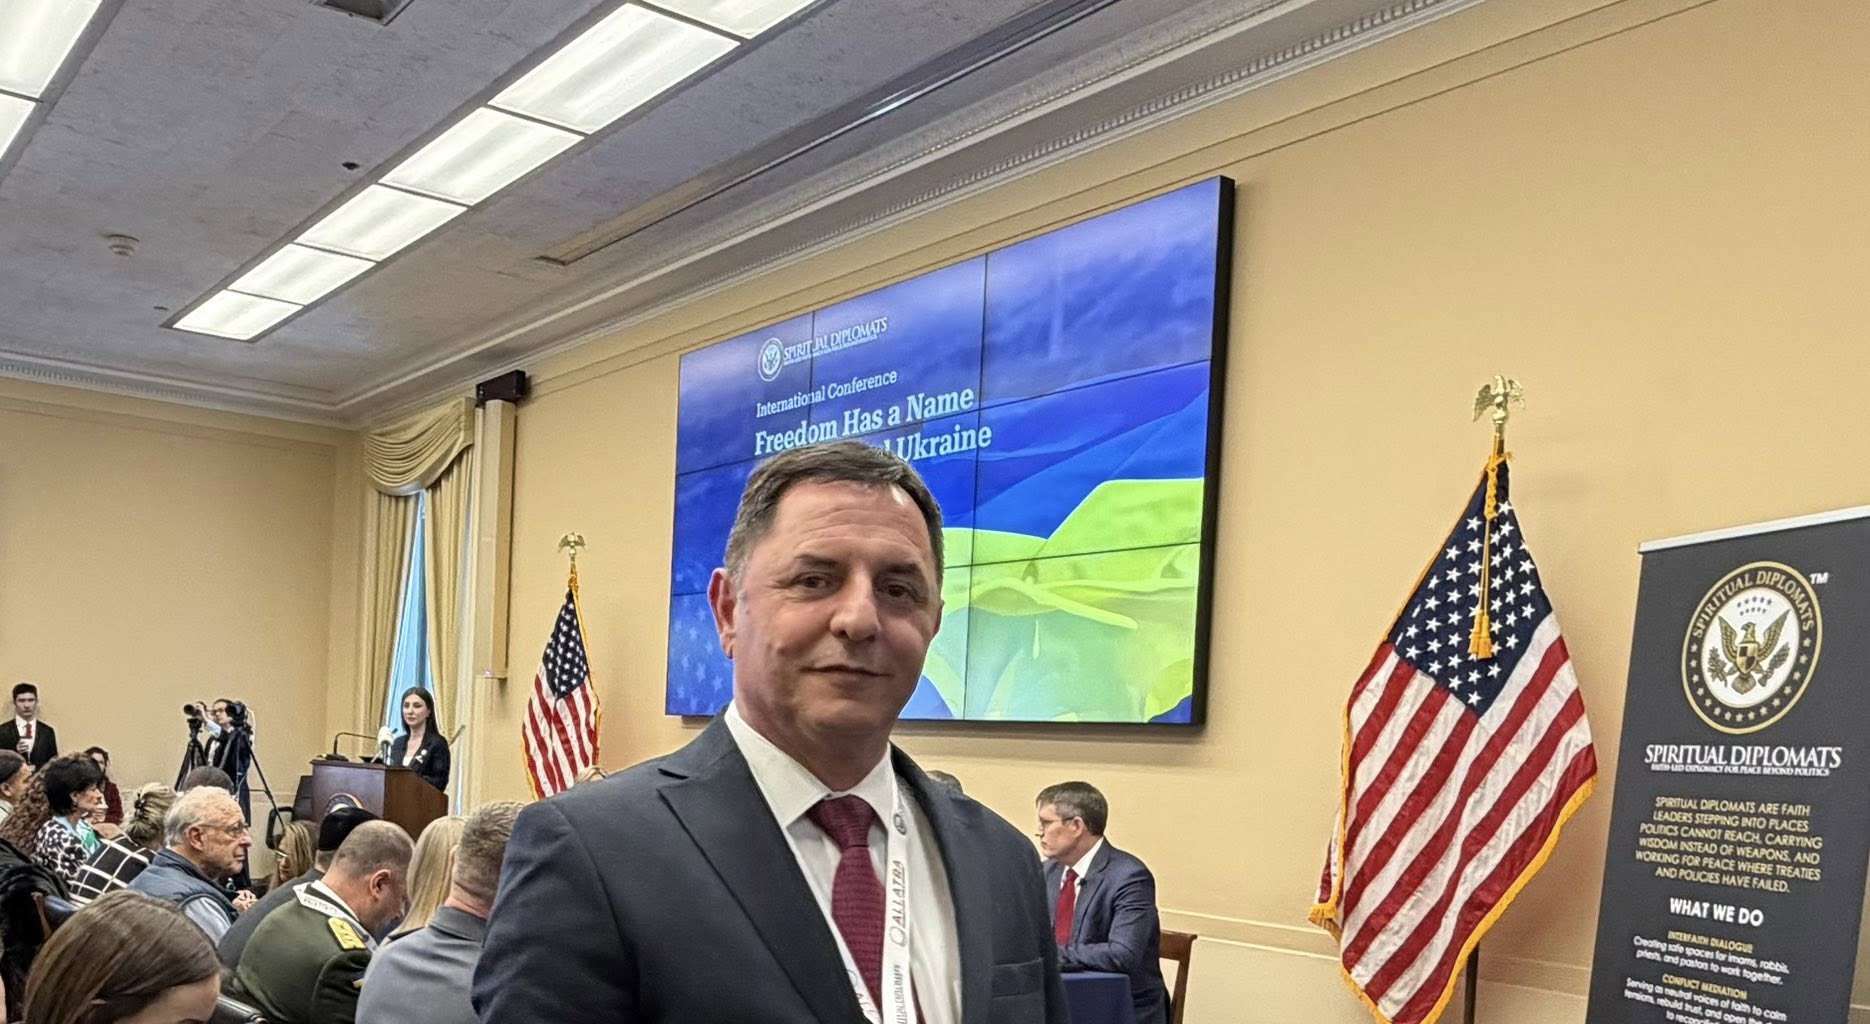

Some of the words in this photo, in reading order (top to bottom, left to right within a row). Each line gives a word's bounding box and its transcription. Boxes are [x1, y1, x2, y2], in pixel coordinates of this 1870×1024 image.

[831, 317, 887, 347] DIPLOMATS
[756, 385, 825, 417] International
[828, 371, 897, 399] Conference
[755, 418, 837, 455] Freedom
[843, 408, 882, 435] Has
[888, 406, 900, 424] a
[906, 388, 974, 422] Name
[897, 423, 992, 462] Ukraine
[1809, 572, 1829, 585] TM
[1693, 573, 1753, 639] SPIRITUAL
[1756, 570, 1814, 632] DIPLOMATS
[1644, 744, 1727, 765] SPIRITUAL
[1731, 745, 1842, 769] DIPLOMATS
[1656, 797, 1698, 810] SPIRITUAL
[1700, 799, 1755, 813] DIPLOMATS
[1758, 803, 1779, 814] ARE
[1782, 803, 1810, 816] FAITH
[1653, 811, 1693, 823] LEADERS
[1695, 813, 1740, 826] STEPPING
[1741, 817, 1766, 829] INTO
[1768, 818, 1808, 832] PLACES
[1640, 823, 1679, 836] POLITICS
[1681, 827, 1722, 840] CANNOT
[1765, 834, 1823, 849] CARRYING
[1639, 838, 1678, 849] WISDOM
[1680, 840, 1717, 854] INSTEAD
[1720, 844, 1734, 855] OF
[1794, 852, 1820, 864] AND
[1636, 850, 1680, 864] WORKING
[1682, 855, 1700, 866] FOR
[1702, 857, 1735, 871] PEACE
[1738, 860, 1773, 875] WHERE
[1776, 865, 1821, 880] TREATIES
[1655, 867, 1678, 879] AND
[1679, 869, 1720, 884] POLICIES
[1722, 875, 1750, 888] HAVE
[1752, 878, 1790, 893] FAILED.
[892, 860, 907, 930] ALLATRA
[1670, 897, 1709, 918] WHAT
[1713, 903, 1734, 922] WE
[1739, 908, 1764, 926] DO
[1634, 936, 1667, 952] Creating
[1686, 947, 1714, 960] spaces
[1716, 949, 1726, 960] for
[1711, 935, 1753, 953] DIALOGUE
[1664, 953, 1679, 965] and
[1710, 963, 1719, 972] to
[1721, 965, 1740, 976] work
[1627, 977, 1653, 992] Serving
[1693, 992, 1718, 1006] voices
[1720, 997, 1729, 1008] of
[1753, 1004, 1762, 1016] to
[1662, 974, 1700, 990] CONFLICT
[1702, 981, 1748, 1000] MEDIATION
[1705, 1006, 1722, 1019] and
[1724, 1013, 1746, 1024] open
